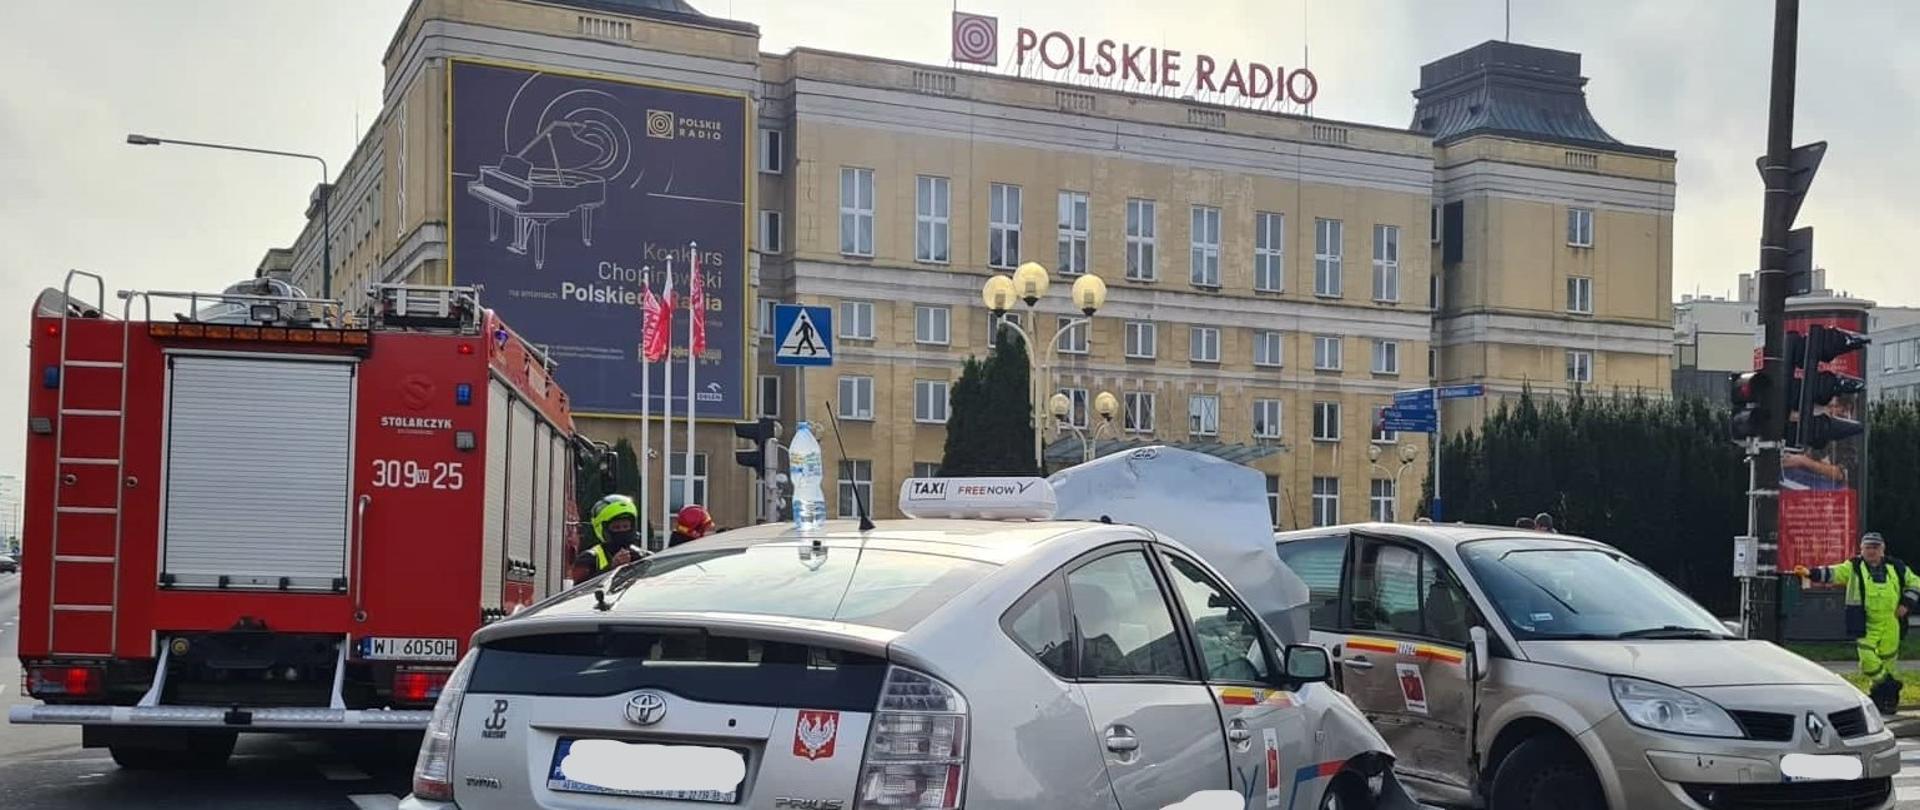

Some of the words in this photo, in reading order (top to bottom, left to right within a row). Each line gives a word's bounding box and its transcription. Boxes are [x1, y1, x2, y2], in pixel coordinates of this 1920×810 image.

[1018, 27, 1181, 87] POLSKIE
[1196, 54, 1318, 105] RADIO
[679, 117, 721, 130] POLSKIE
[679, 128, 721, 141] RADIO
[381, 416, 452, 429] STOLARCZYK
[371, 459, 417, 488] 309
[418, 469, 430, 483] W
[432, 462, 463, 490] 25
[913, 481, 945, 495] TAXI
[403, 639, 455, 656] 6050H
